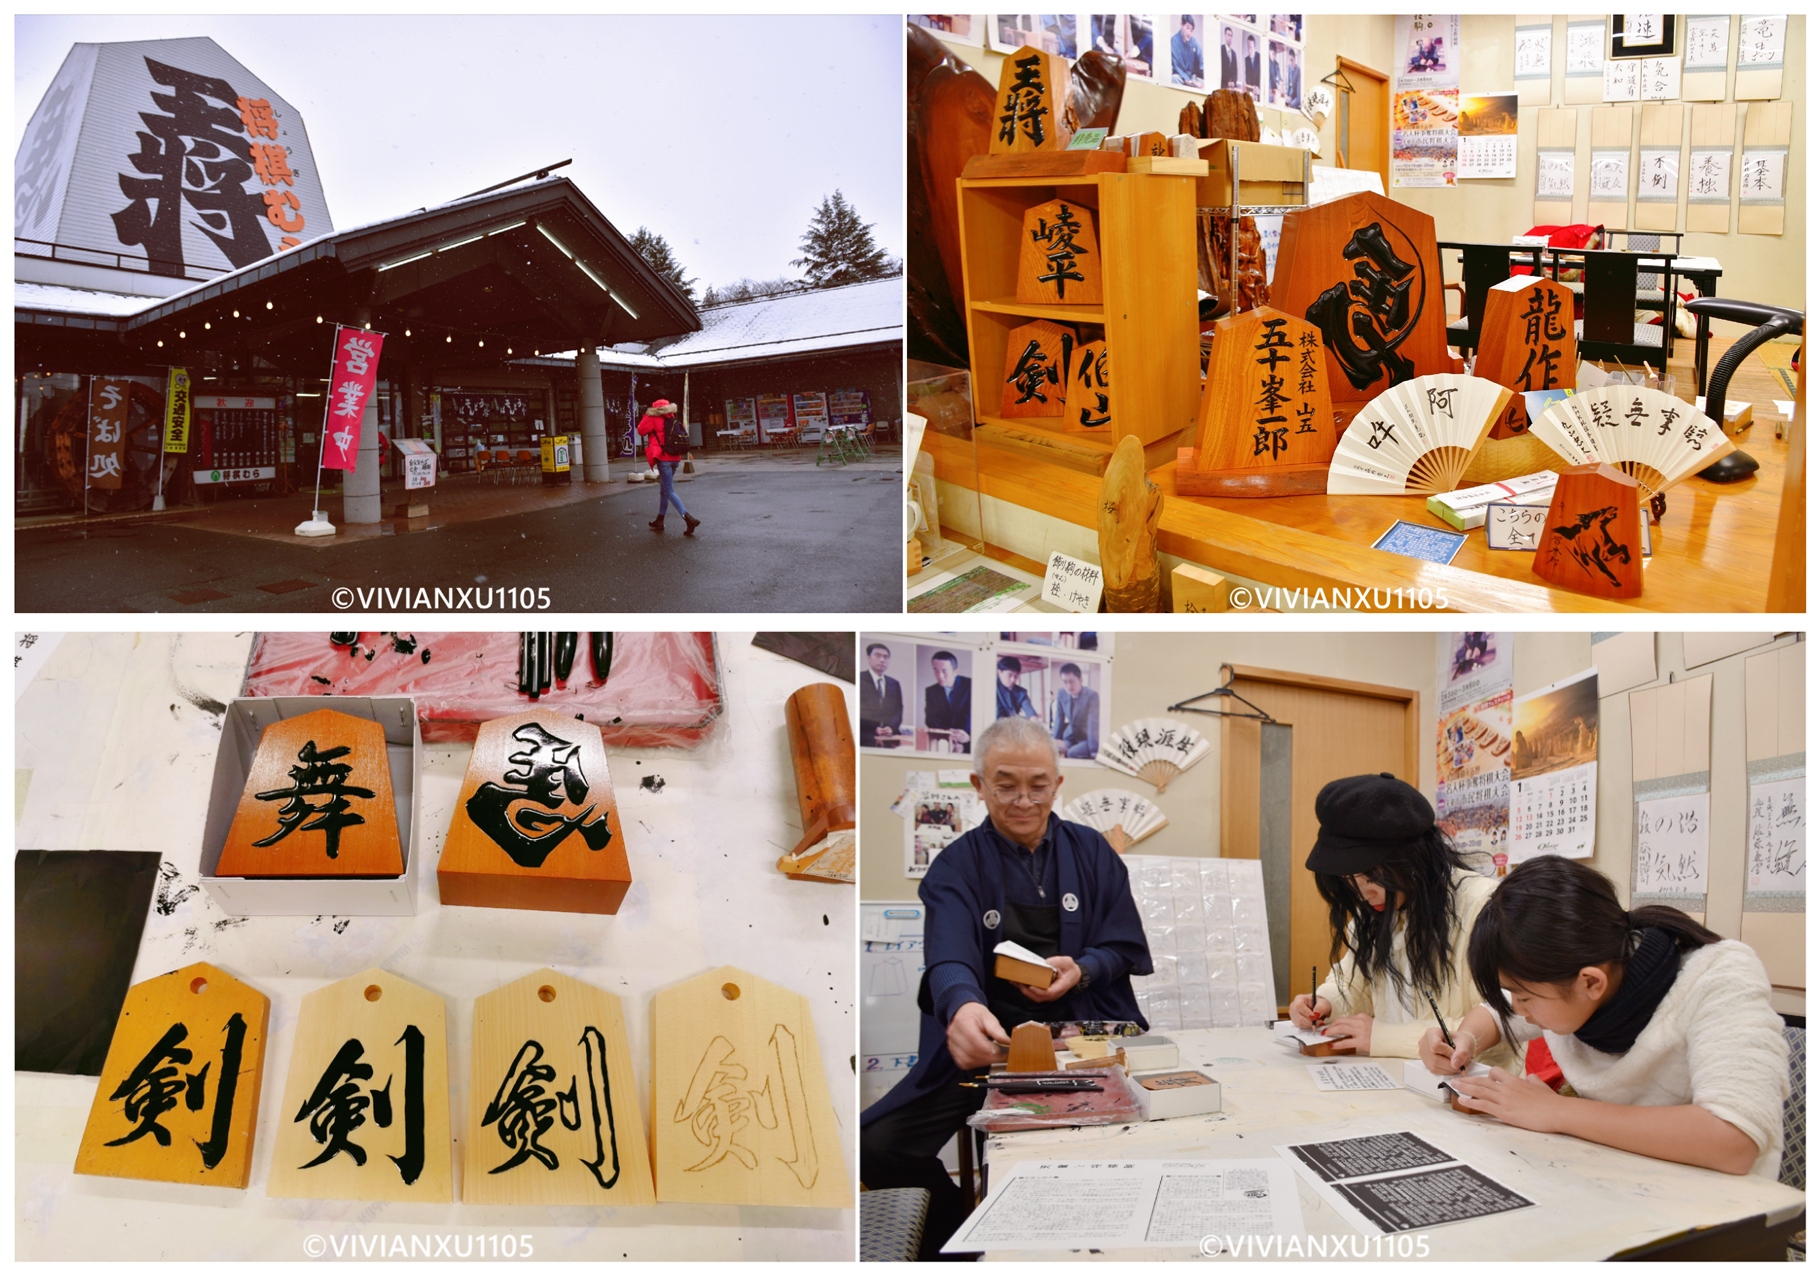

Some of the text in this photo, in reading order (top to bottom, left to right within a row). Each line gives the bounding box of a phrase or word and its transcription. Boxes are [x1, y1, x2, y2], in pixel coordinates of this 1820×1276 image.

[1072, 133, 1100, 145] 非売品
[1651, 156, 1668, 189] 不倒
[1750, 158, 1772, 191] 基本
[1254, 319, 1294, 460] 五十峯一郎
[1294, 331, 1319, 435] 株式会社 山五
[1514, 287, 1566, 391] 龍作
[170, 389, 188, 442] 交通安全
[333, 336, 375, 463] 営業中
[223, 469, 260, 480] 将棋むら
[1496, 507, 1548, 525] こちらの
[1052, 555, 1099, 585] 飾り駒の材料
[252, 740, 376, 858] 舞
[1446, 768, 1509, 795] 名人杯争奪将棋大会
[103, 1012, 247, 1169] 剣
[294, 1024, 425, 1186] 剣
[481, 1026, 620, 1189] 剣
[673, 1023, 820, 1189] 剣
